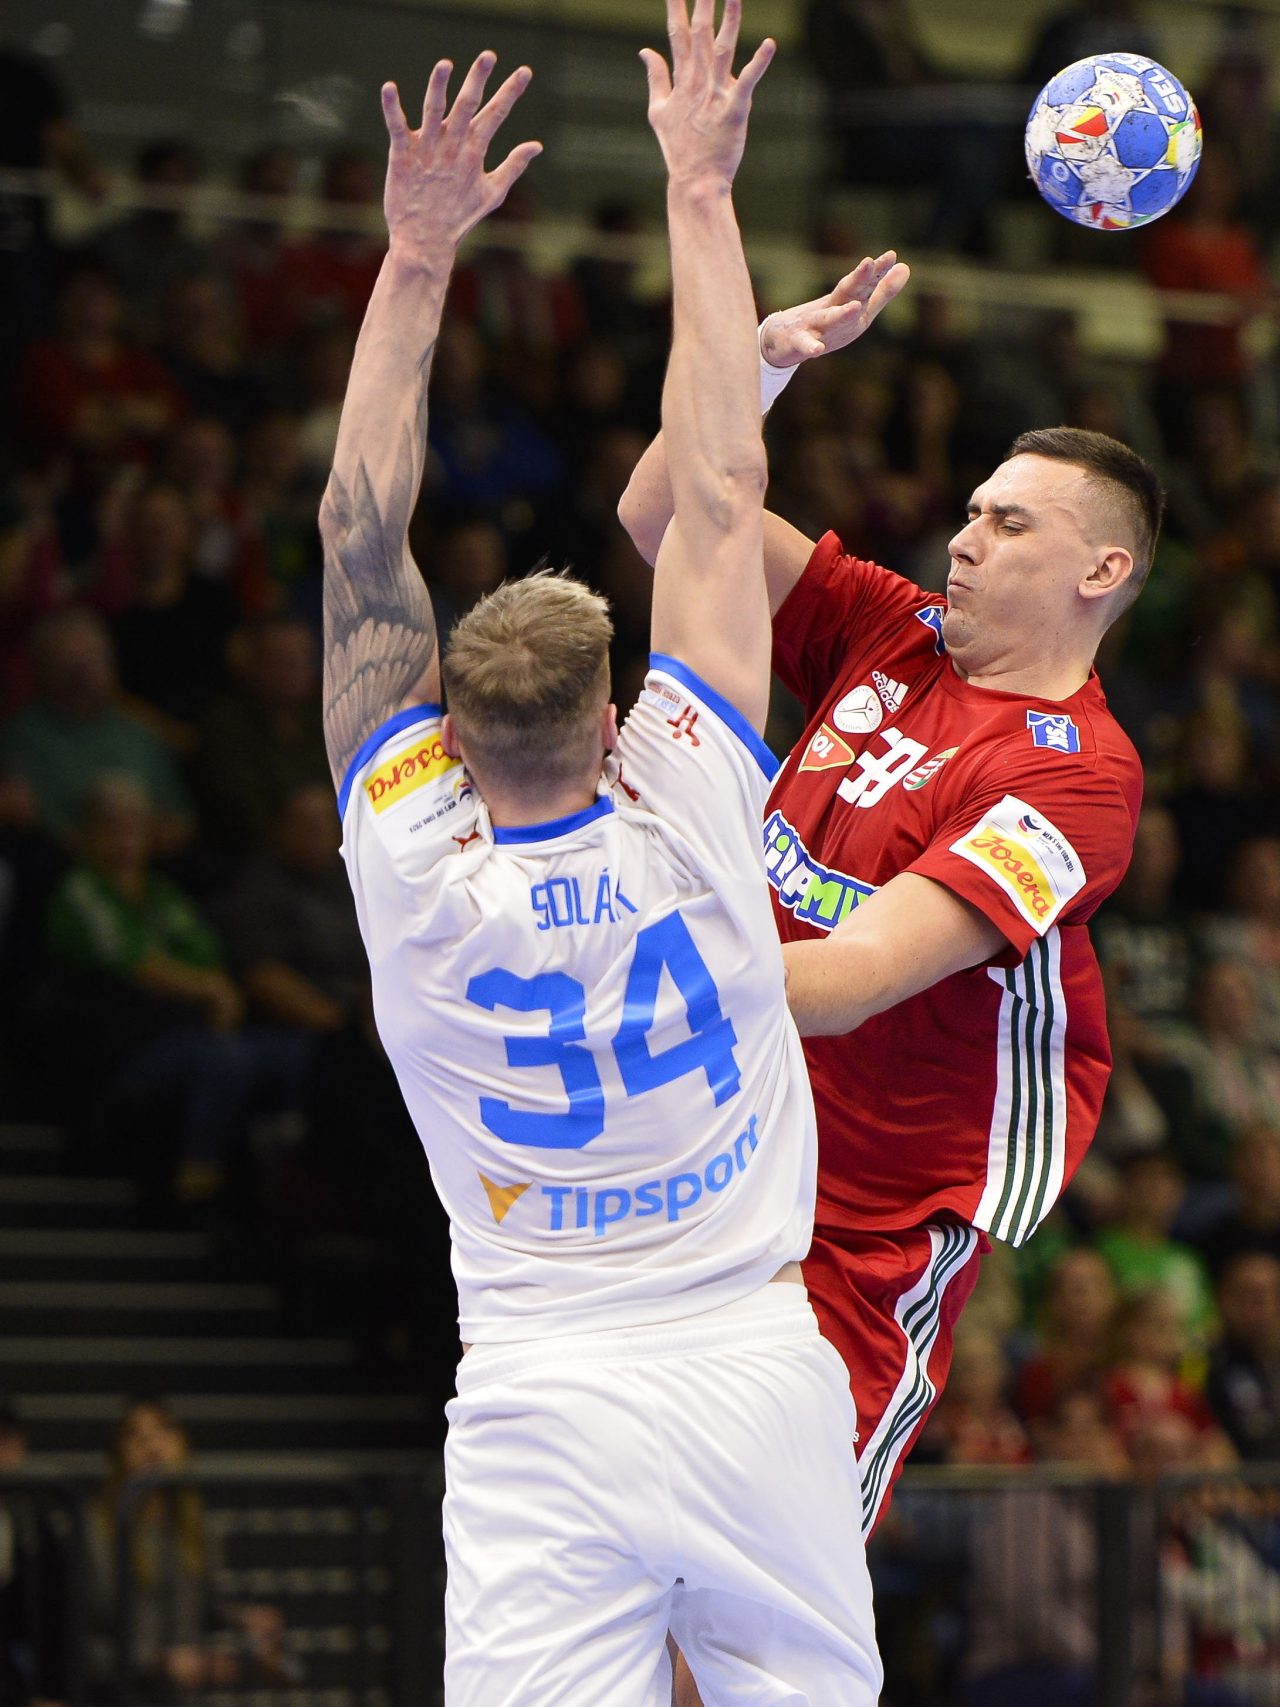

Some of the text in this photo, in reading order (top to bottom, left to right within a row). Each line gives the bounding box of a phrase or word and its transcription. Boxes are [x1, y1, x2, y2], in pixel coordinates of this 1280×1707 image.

[871, 670, 900, 714] adidas
[368, 740, 452, 803] osera
[971, 835, 1051, 918] Josera
[466, 909, 742, 1150] 34
[541, 1114, 760, 1237] Tipsport
